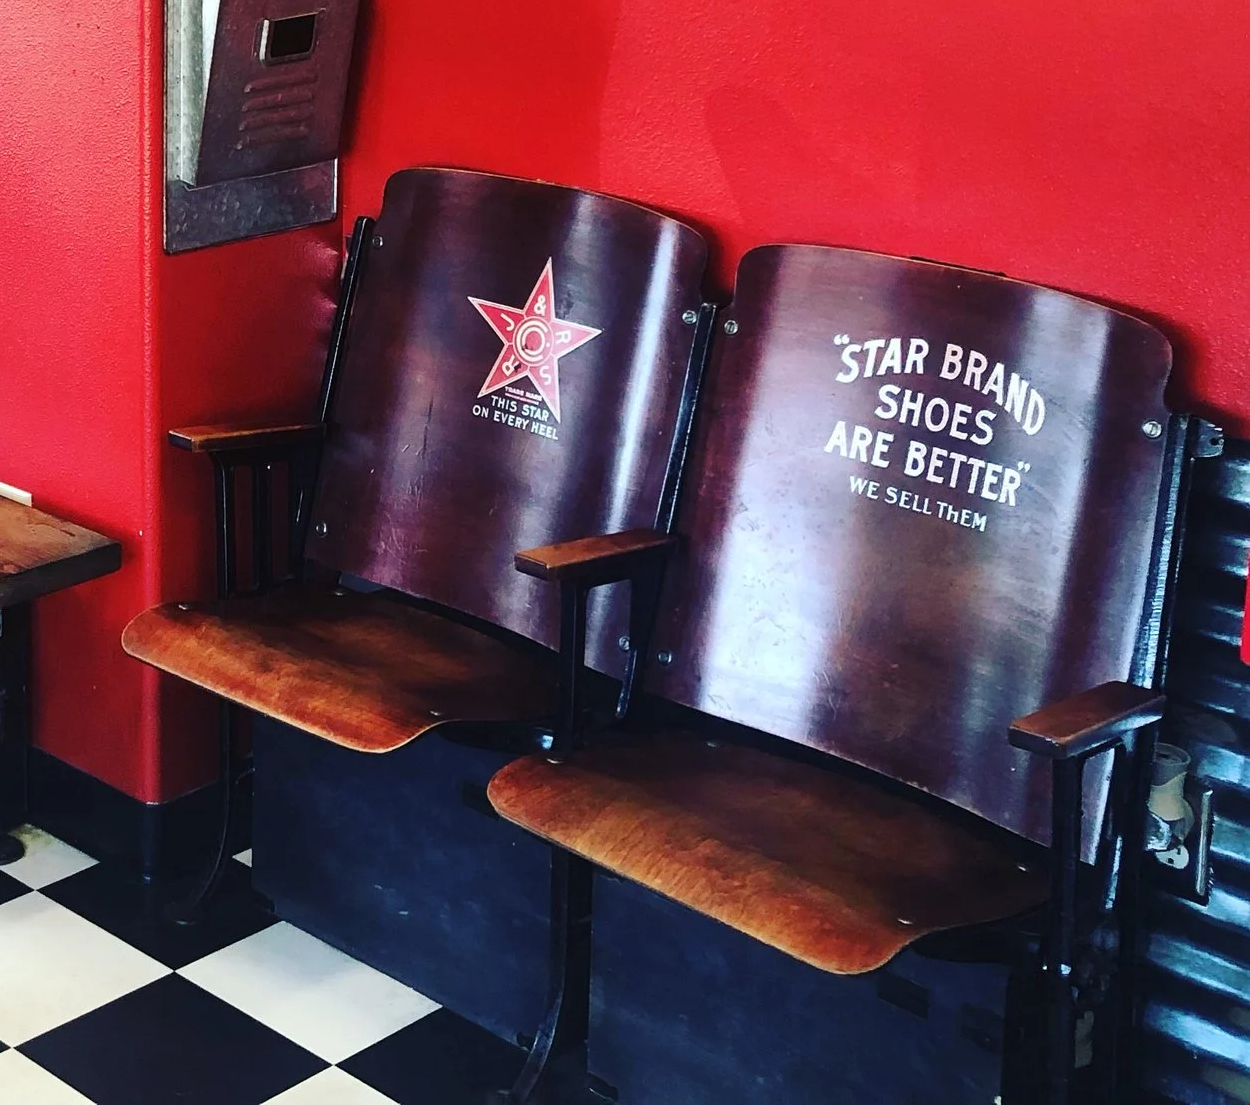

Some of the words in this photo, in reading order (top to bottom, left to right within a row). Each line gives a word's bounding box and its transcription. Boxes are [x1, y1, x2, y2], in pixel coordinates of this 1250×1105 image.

[491, 395, 517, 413] THIS
[522, 406, 549, 422] STAR
[939, 344, 1045, 436] BRAND
[472, 404, 489, 418] ON
[494, 411, 530, 430] EVERY
[531, 421, 558, 441] HEEL
[874, 384, 997, 446] SHOES
[823, 420, 894, 468] ARE
[850, 475, 879, 500] WE
[884, 486, 933, 515] SELL
